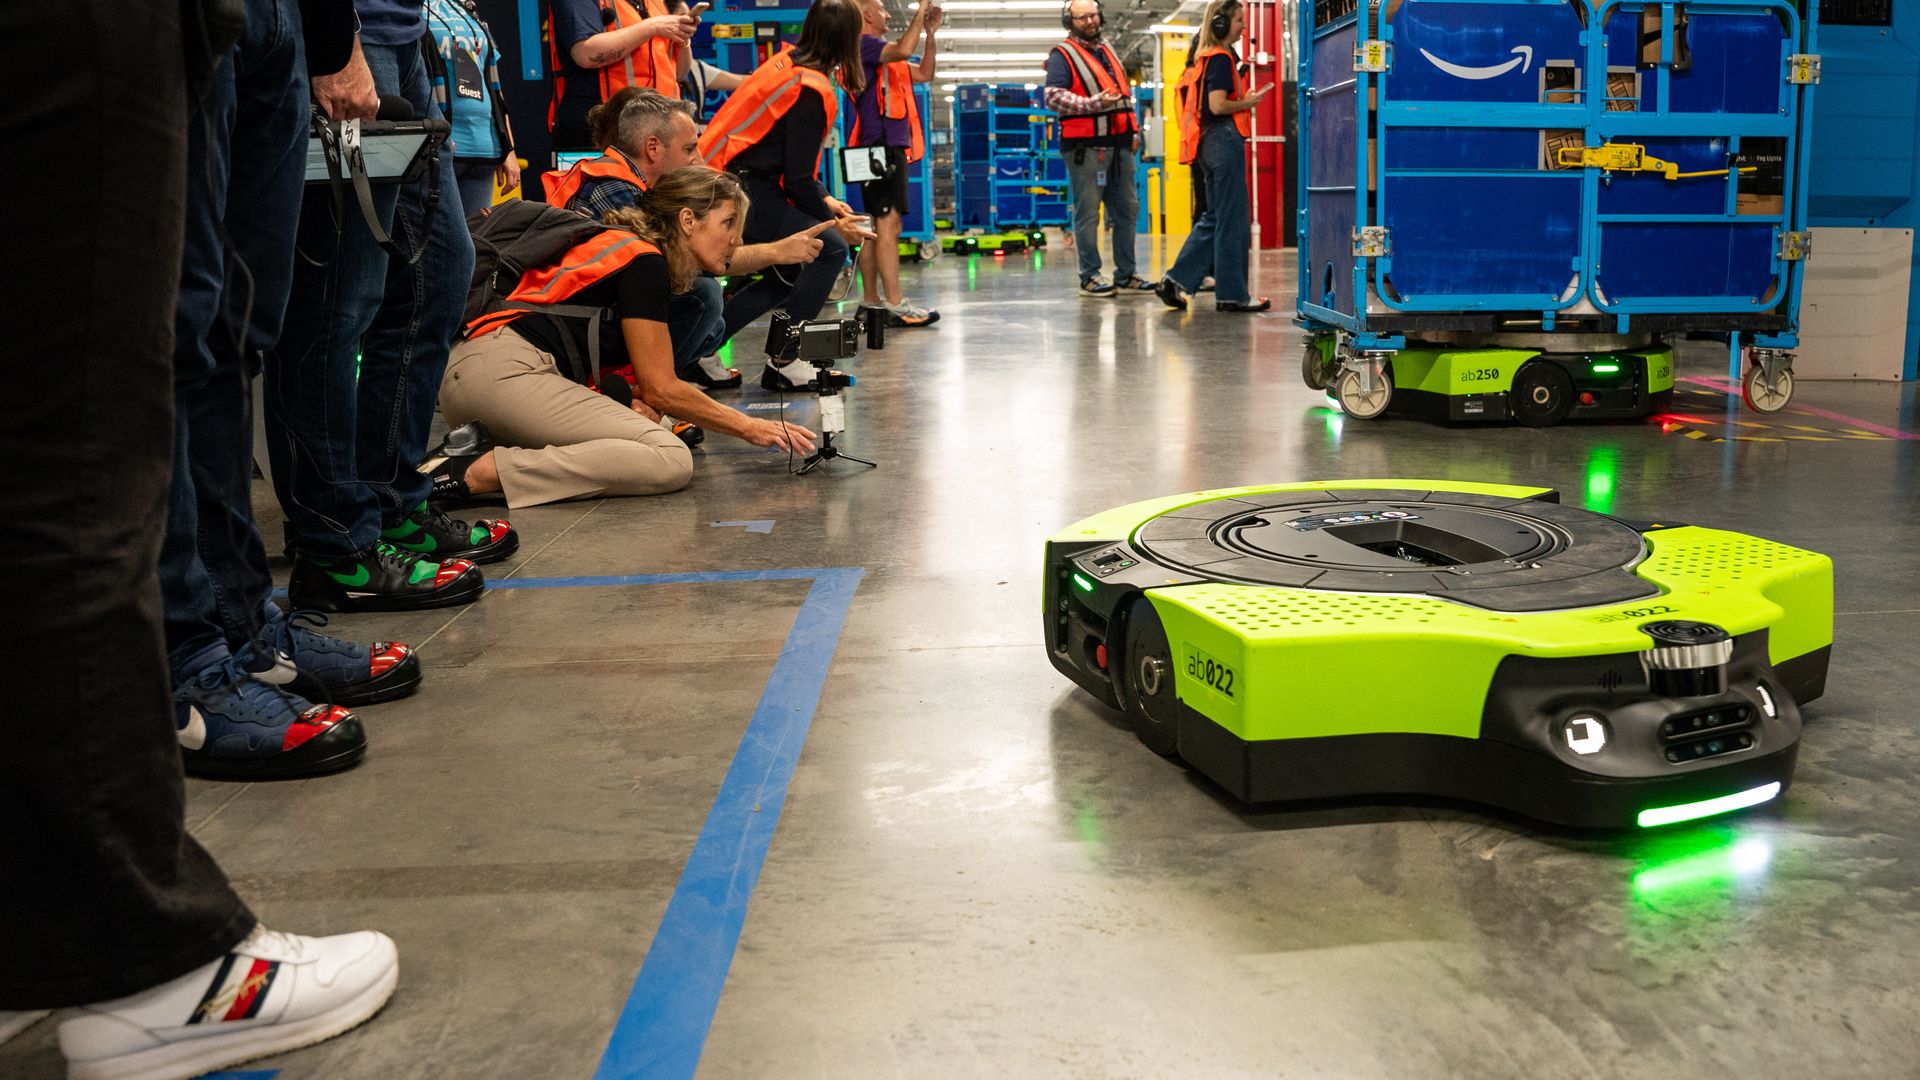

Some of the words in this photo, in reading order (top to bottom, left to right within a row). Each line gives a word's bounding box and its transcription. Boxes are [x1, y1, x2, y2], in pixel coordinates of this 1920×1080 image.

[459, 85, 482, 99] Guest
[1756, 154, 1766, 163] Fog
[1766, 154, 1782, 163] Lights
[1461, 368, 1499, 382] ab250
[1593, 605, 1679, 623] ab022
[1188, 651, 1233, 698] ab022
